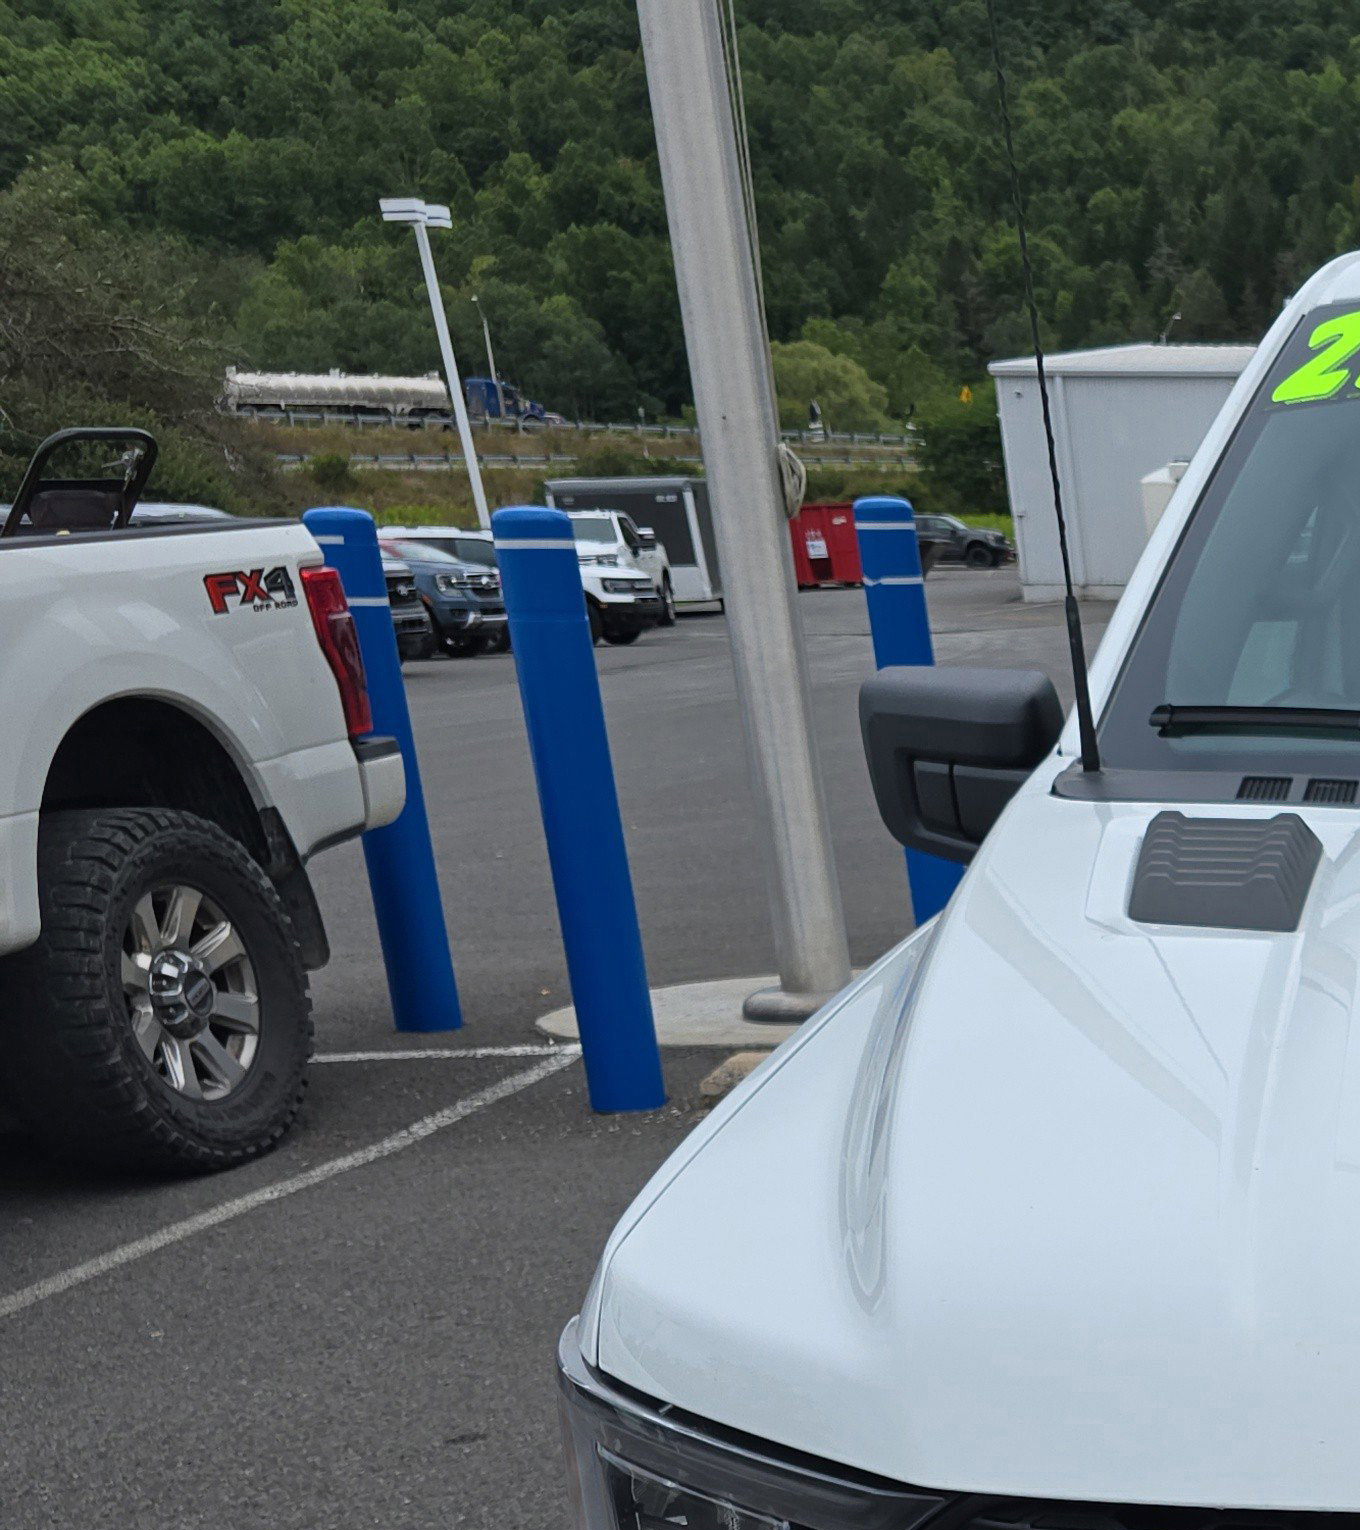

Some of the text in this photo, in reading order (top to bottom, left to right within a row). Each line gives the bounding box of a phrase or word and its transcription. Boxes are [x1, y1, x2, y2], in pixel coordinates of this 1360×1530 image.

[203, 566, 298, 614] FX4
[253, 600, 299, 612] OFF ROAD
